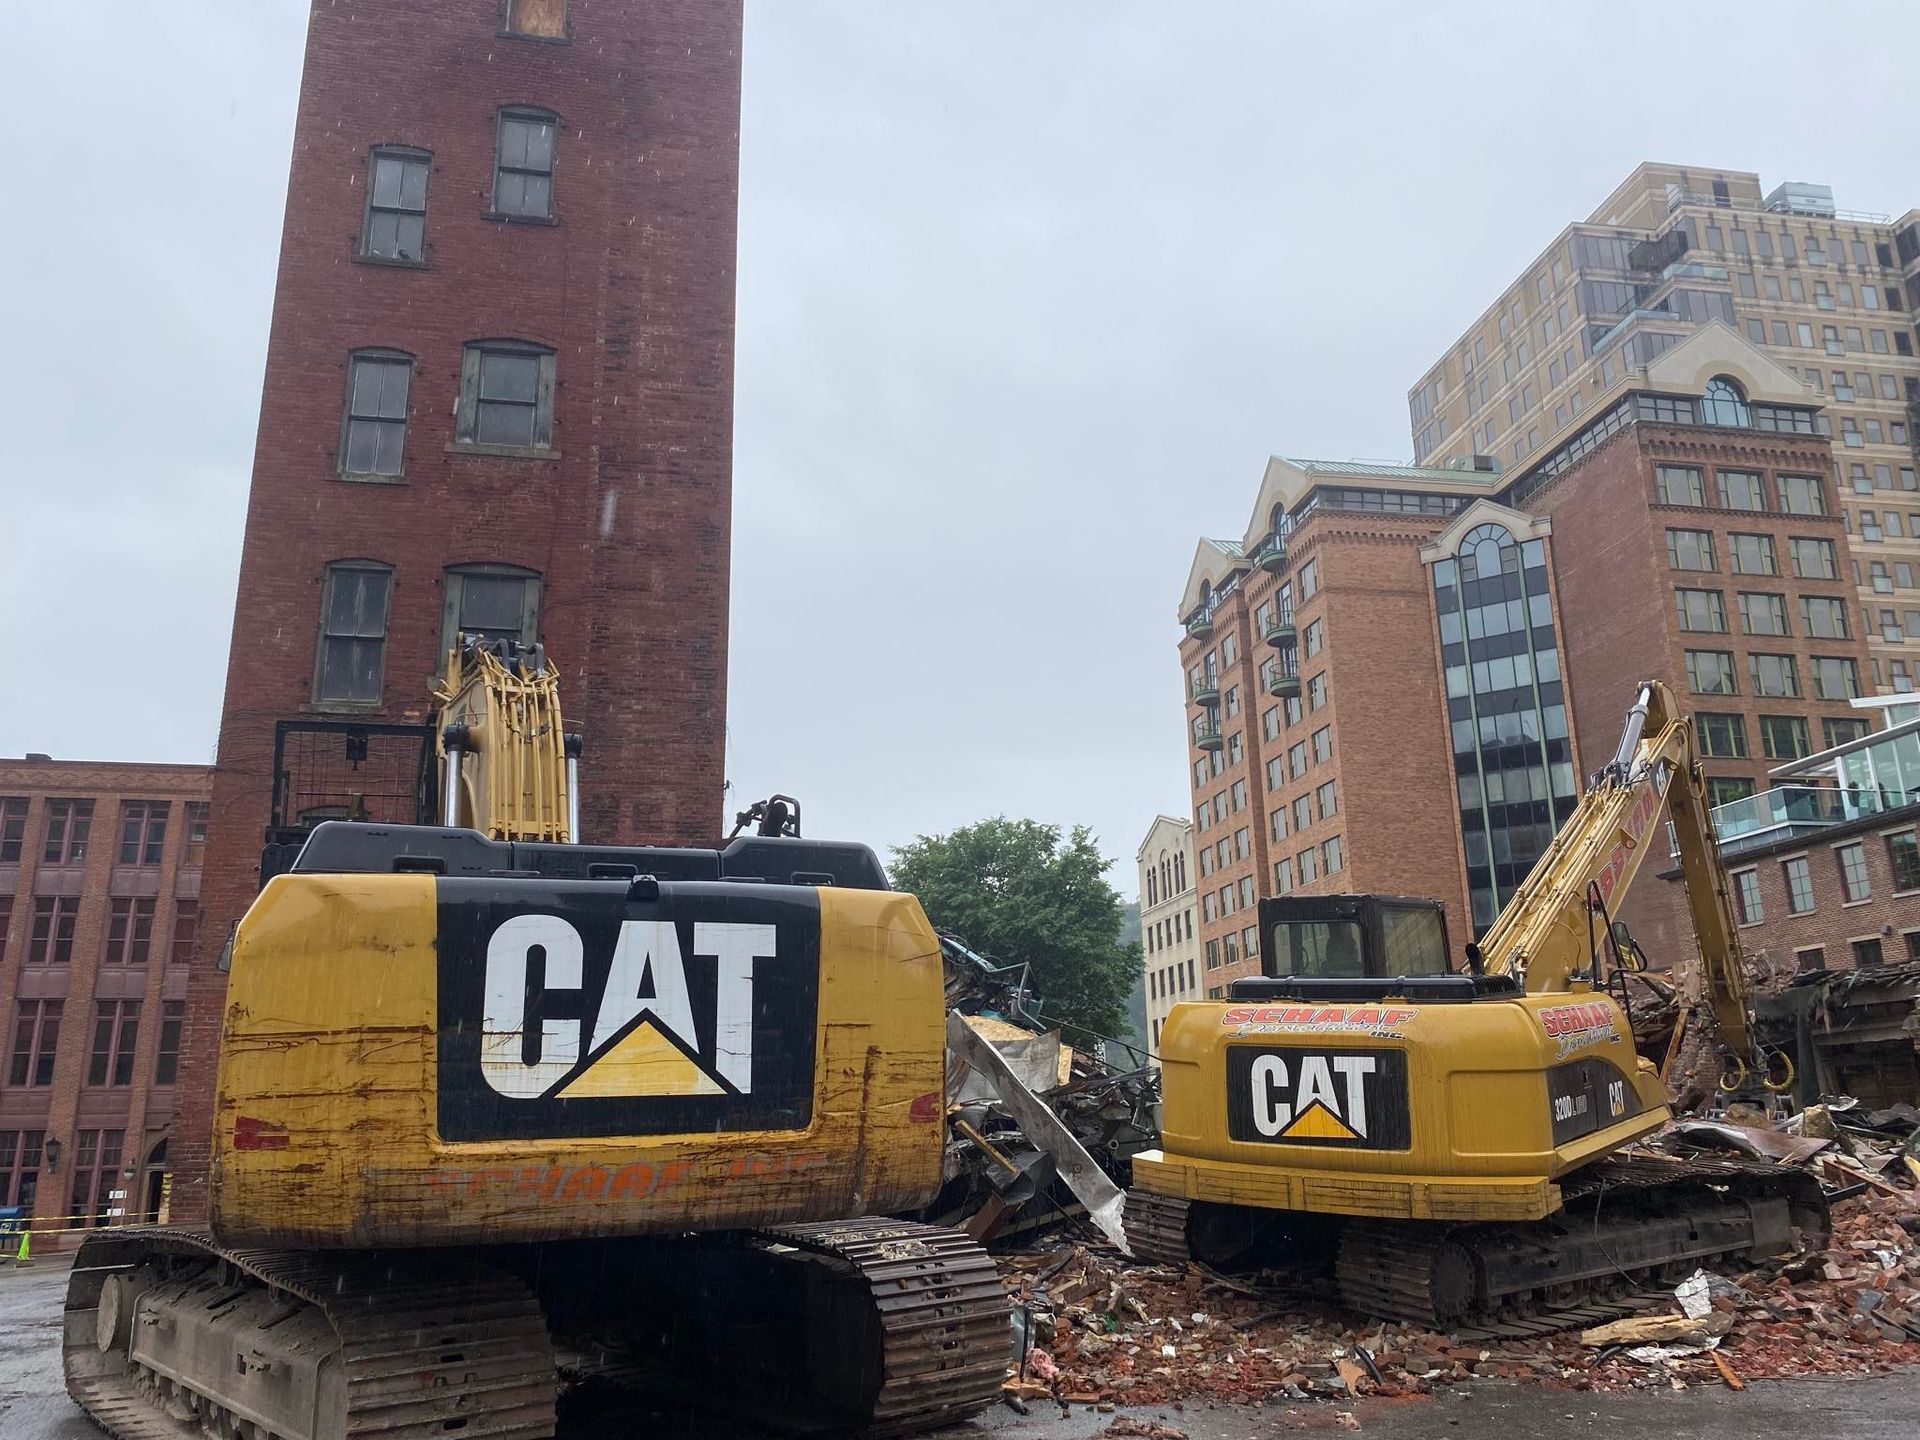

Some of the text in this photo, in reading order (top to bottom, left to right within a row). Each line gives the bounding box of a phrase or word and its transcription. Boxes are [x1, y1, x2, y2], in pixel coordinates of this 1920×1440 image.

[481, 914, 777, 1100] CAT
[1222, 1008, 1418, 1027] SCHAAF
[1538, 1001, 1613, 1038] SCHAAF
[1251, 1054, 1375, 1138] CAT
[1608, 1080, 1625, 1117] CAT
